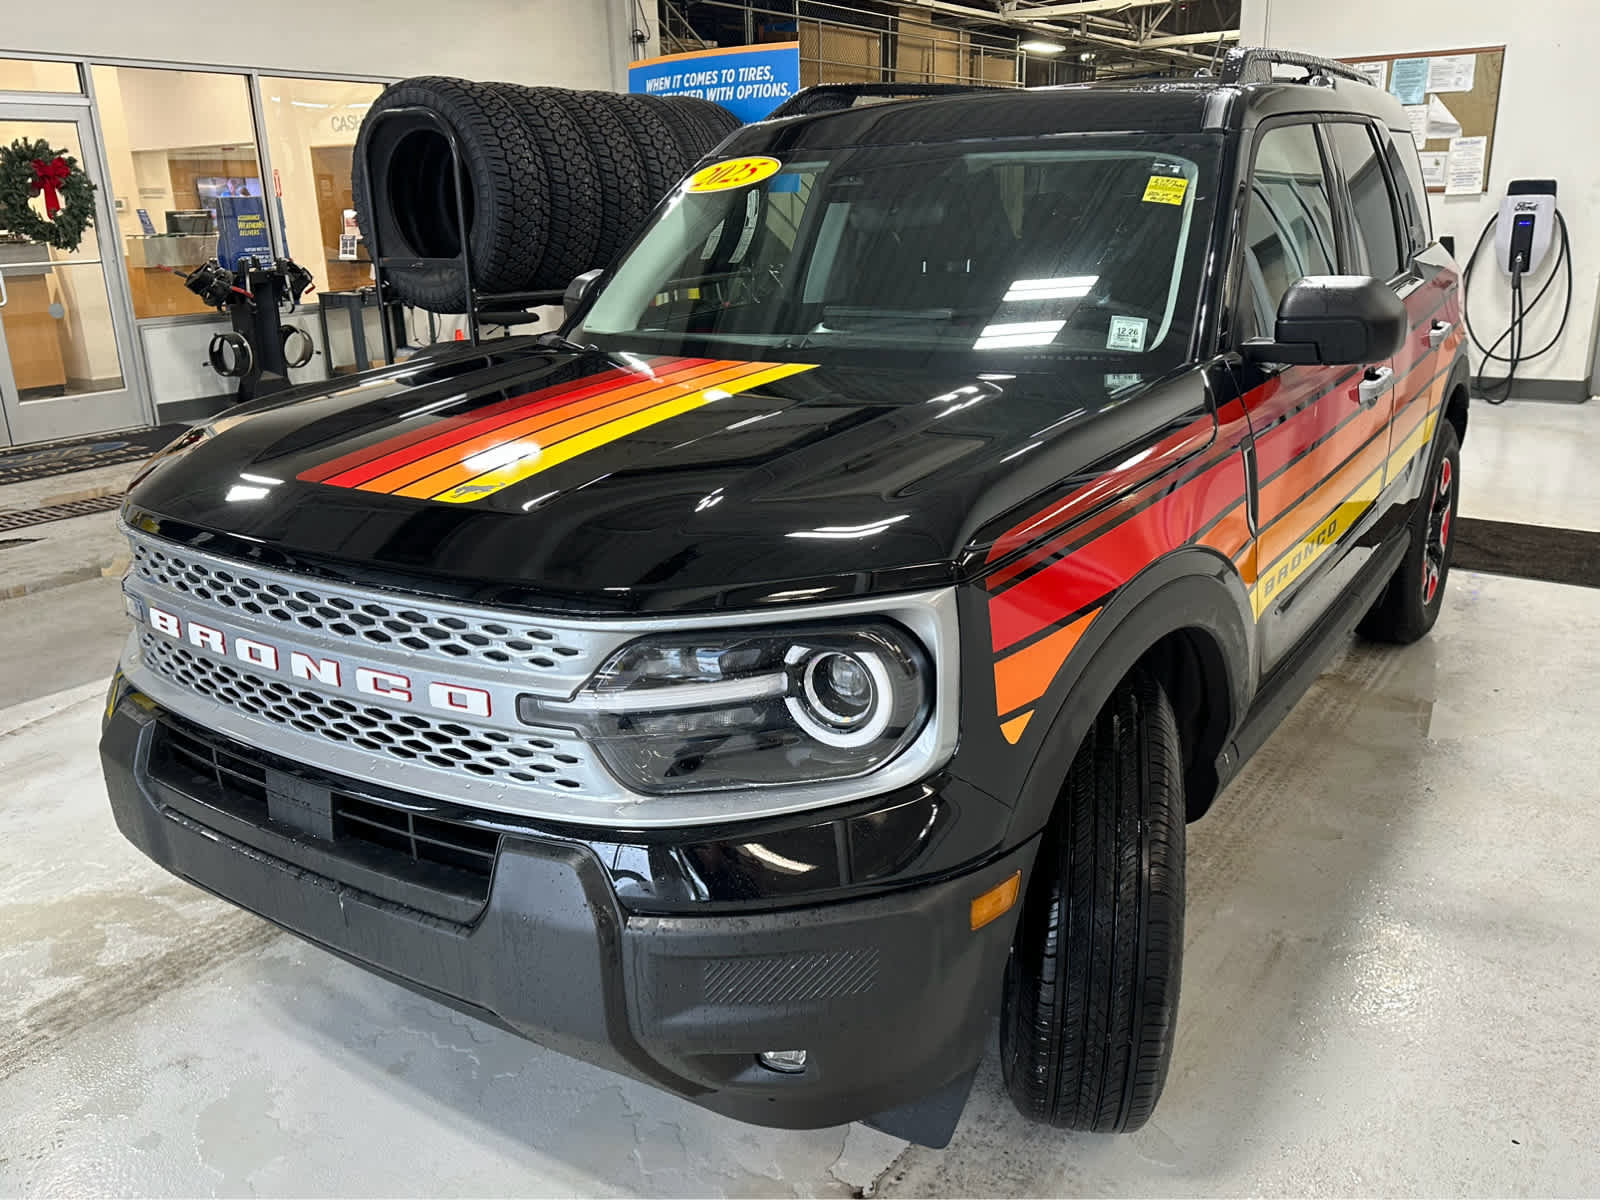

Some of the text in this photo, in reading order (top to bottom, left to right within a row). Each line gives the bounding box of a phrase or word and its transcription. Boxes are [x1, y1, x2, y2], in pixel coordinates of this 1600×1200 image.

[646, 65, 775, 92] WHEN IT COMES TO TIRES,
[706, 86, 735, 101] WITH
[736, 82, 792, 99] OPTIONS.
[1514, 201, 1539, 212] Ford
[1263, 519, 1338, 598] BRONCO
[149, 607, 491, 718] BRONCO
